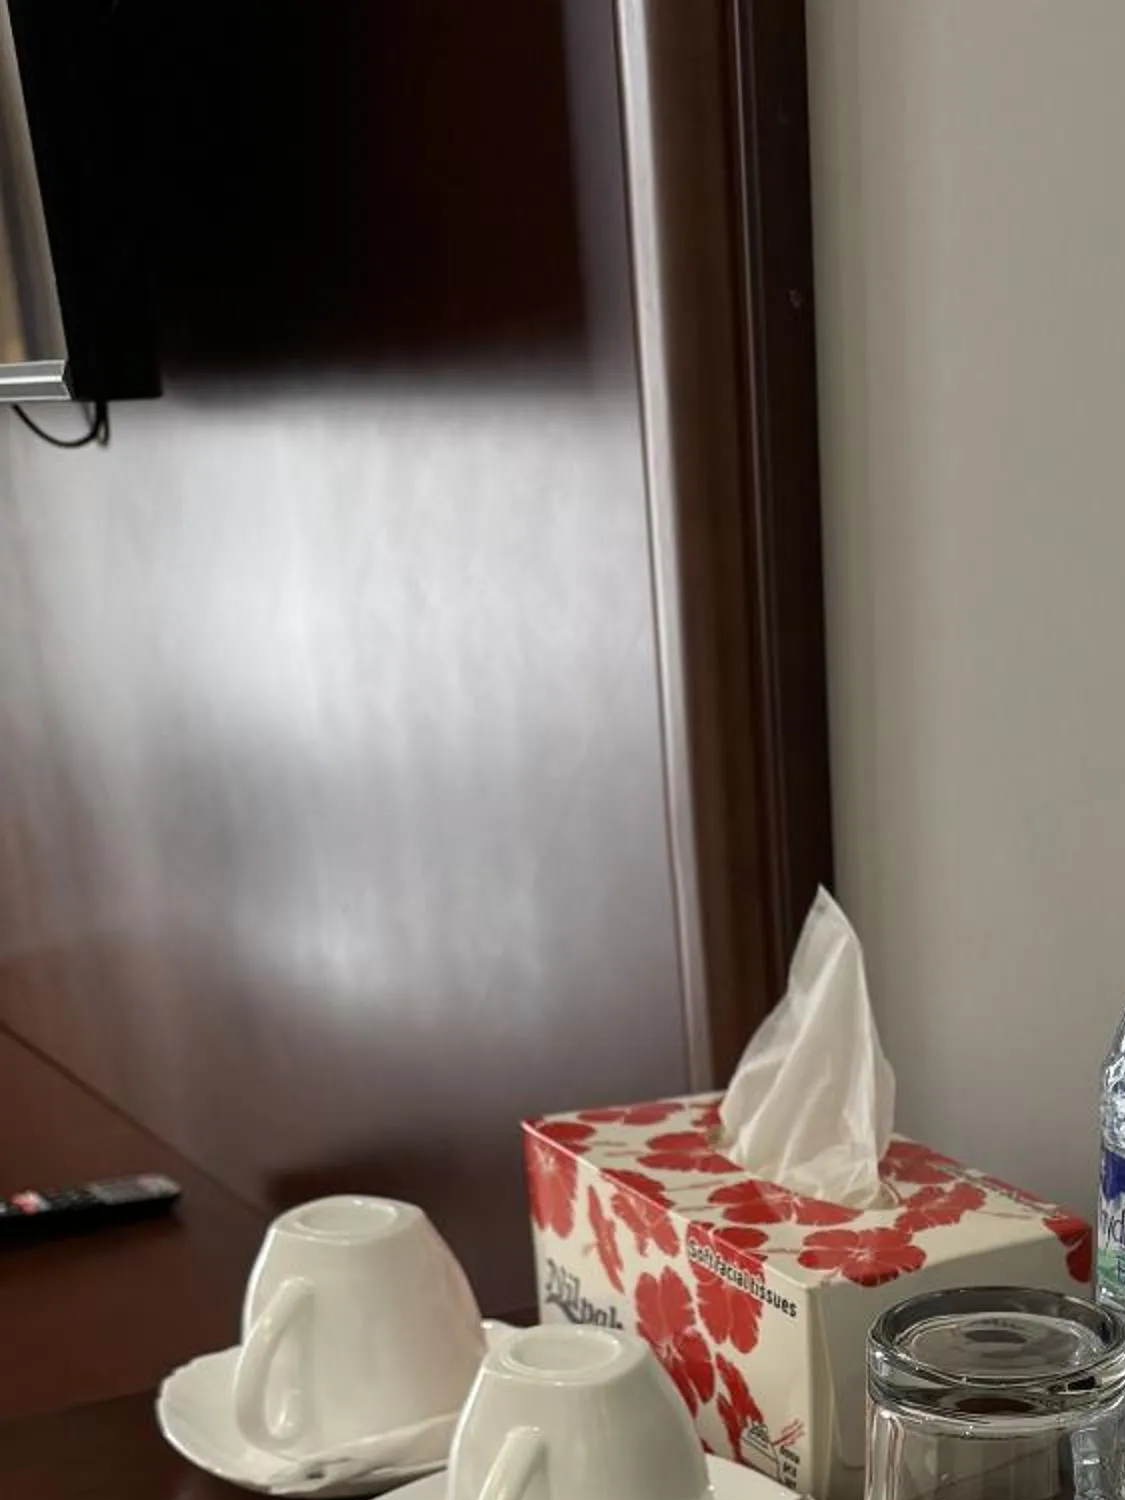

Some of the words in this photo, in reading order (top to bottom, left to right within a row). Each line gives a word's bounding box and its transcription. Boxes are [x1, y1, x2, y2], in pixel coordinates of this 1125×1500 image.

[687, 1239, 714, 1267] Soft
[713, 1254, 749, 1290] facial
[750, 1277, 798, 1318] tissues
